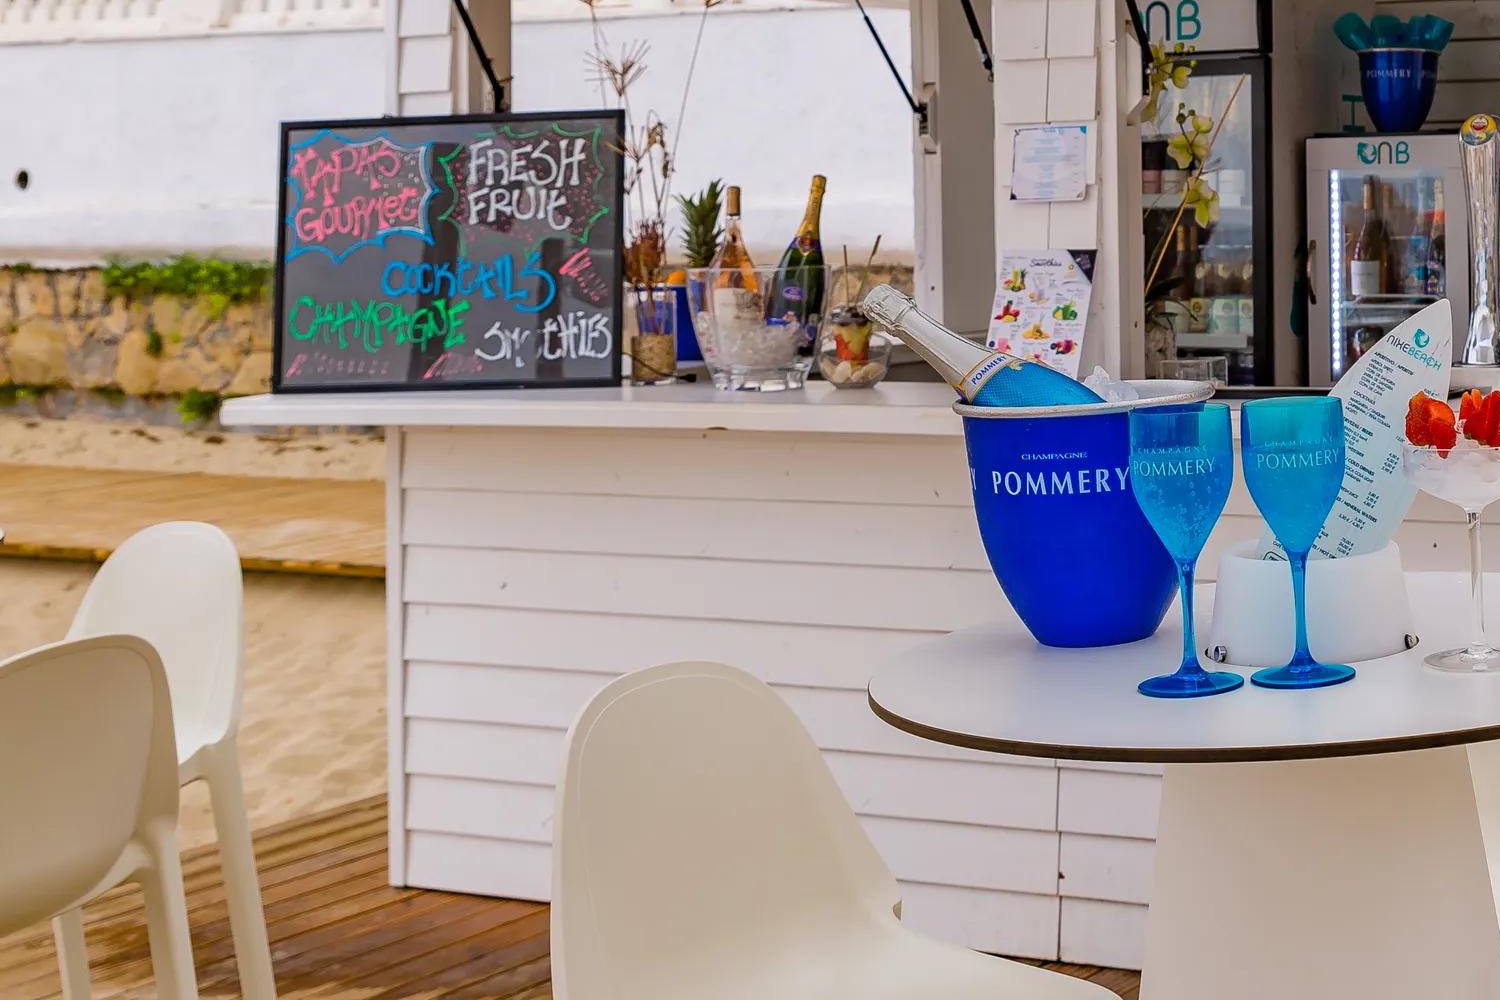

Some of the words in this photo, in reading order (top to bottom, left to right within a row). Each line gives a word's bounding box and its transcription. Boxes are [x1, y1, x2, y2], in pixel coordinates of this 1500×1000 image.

[1145, 0, 1201, 41] NB
[466, 137, 587, 188] FRESH
[1378, 141, 1410, 164] NB
[1387, 335, 1442, 370] NIXEBEACH
[972, 355, 1007, 385] POMMERY
[1021, 451, 1089, 461] CHAMPAGNE
[1133, 457, 1215, 477] POMMERY
[1257, 448, 1339, 470] POMMERY
[992, 466, 1130, 496] POMMERY
